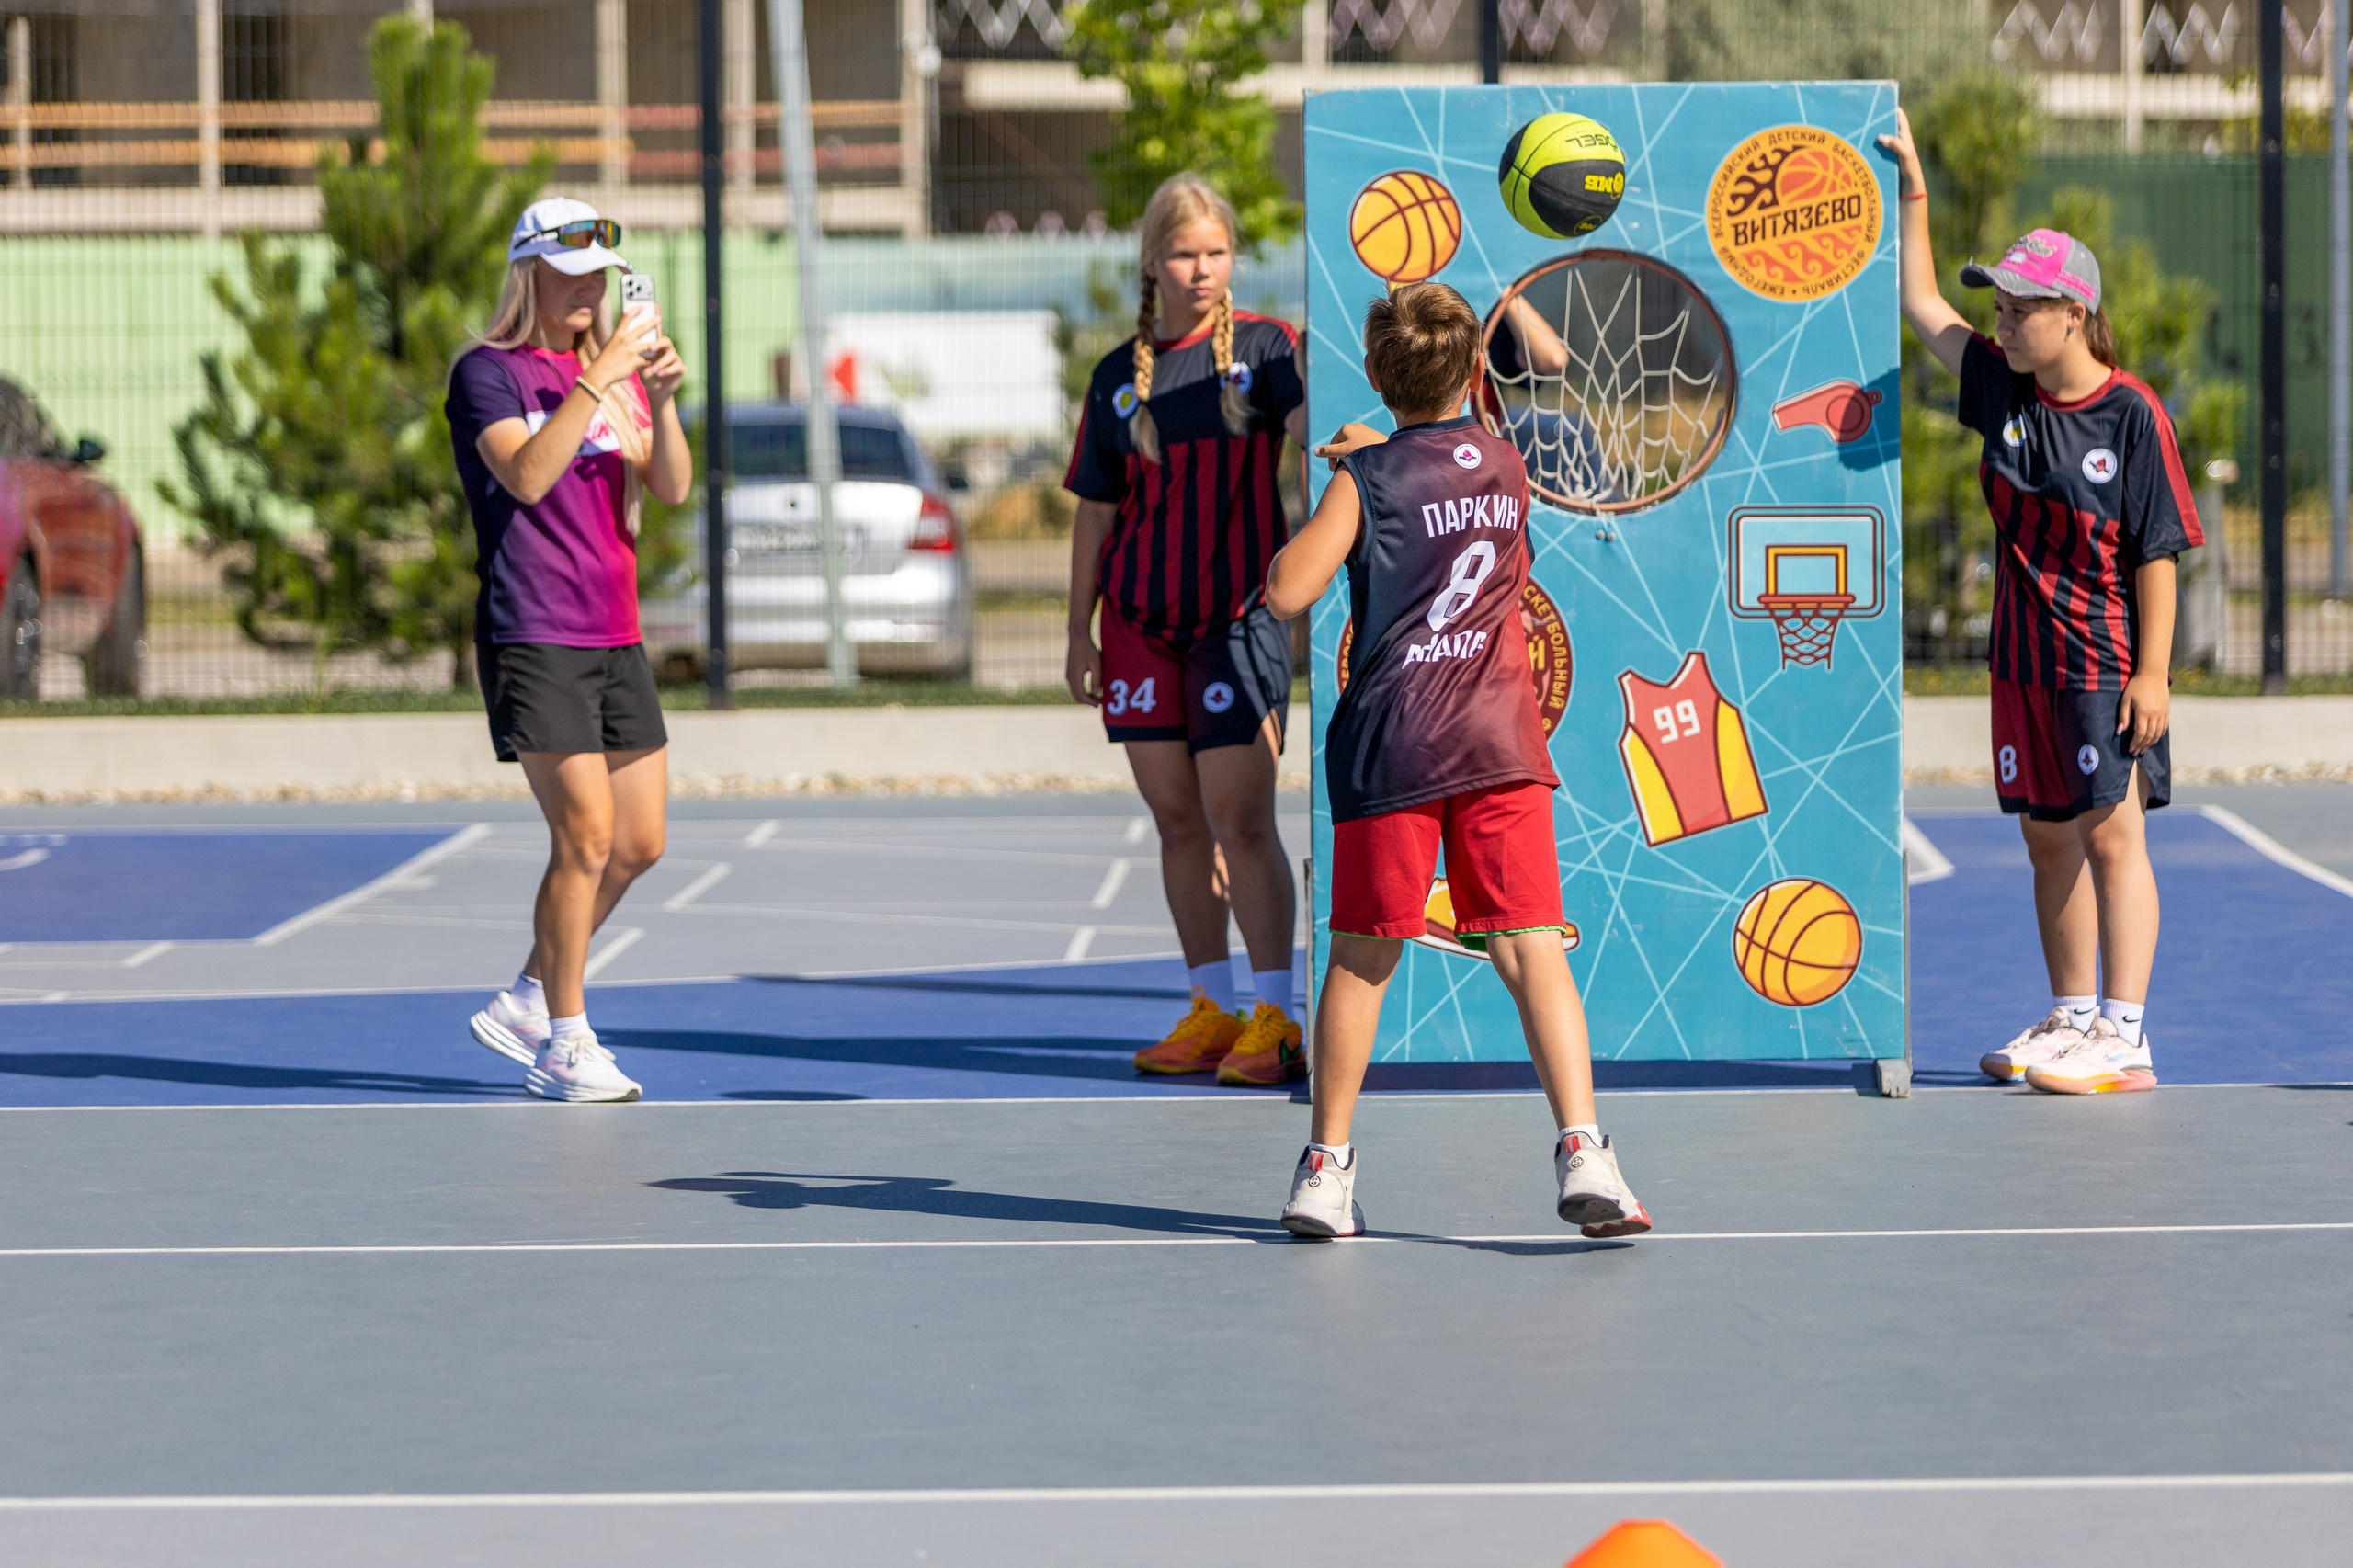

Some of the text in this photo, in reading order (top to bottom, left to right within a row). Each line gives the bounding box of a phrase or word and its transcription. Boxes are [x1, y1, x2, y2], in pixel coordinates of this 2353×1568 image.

[1564, 134, 1618, 152] ÖGEL
[1768, 130, 1827, 145] ДЕТСКИЙ
[1711, 139, 1761, 239] ВСЕРОССИЙСКИЙ
[1832, 143, 1877, 244] БАСКЕТБОЛЬНЫЙ
[1731, 194, 1861, 246] ВИТЯЗЕВО
[1802, 250, 1865, 295] ФЕСТИВАЛЬ
[1421, 494, 1518, 538] ПАРКИН
[1427, 540, 1496, 632] 8
[1522, 585, 1568, 710] СКЕТБОЛЬНЫЙ
[1107, 677, 1156, 715] 34
[1654, 699, 1700, 744] 99
[1998, 744, 2017, 784] 8
